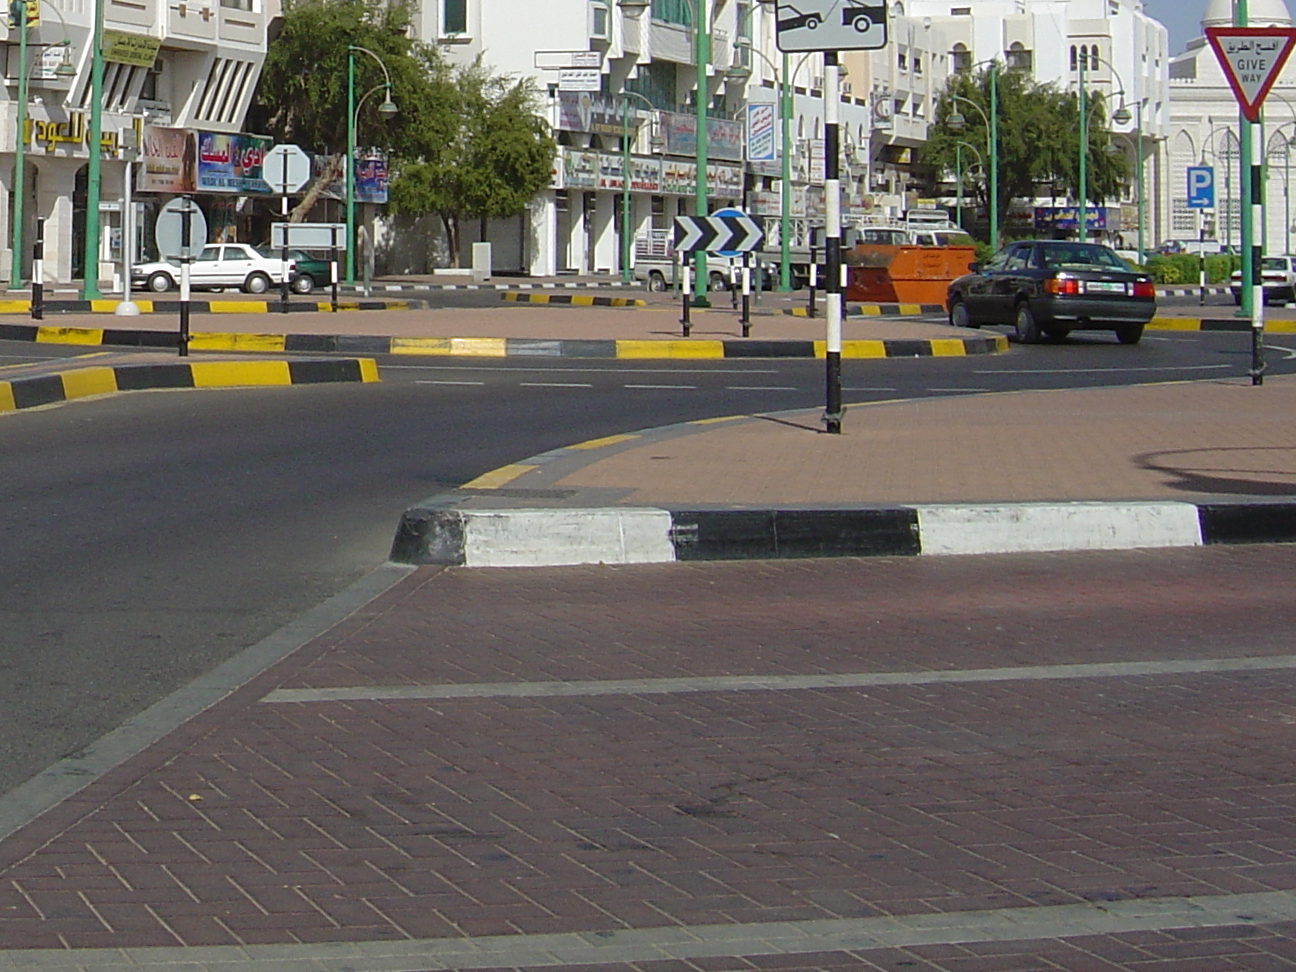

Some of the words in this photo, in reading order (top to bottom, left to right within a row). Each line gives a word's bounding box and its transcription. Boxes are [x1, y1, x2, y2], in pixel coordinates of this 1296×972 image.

[1226, 40, 1254, 54] الطريق
[1255, 41, 1278, 55] افسح
[1237, 59, 1266, 70] GIVE
[1241, 74, 1262, 83] WAY
[1189, 169, 1212, 198] P
